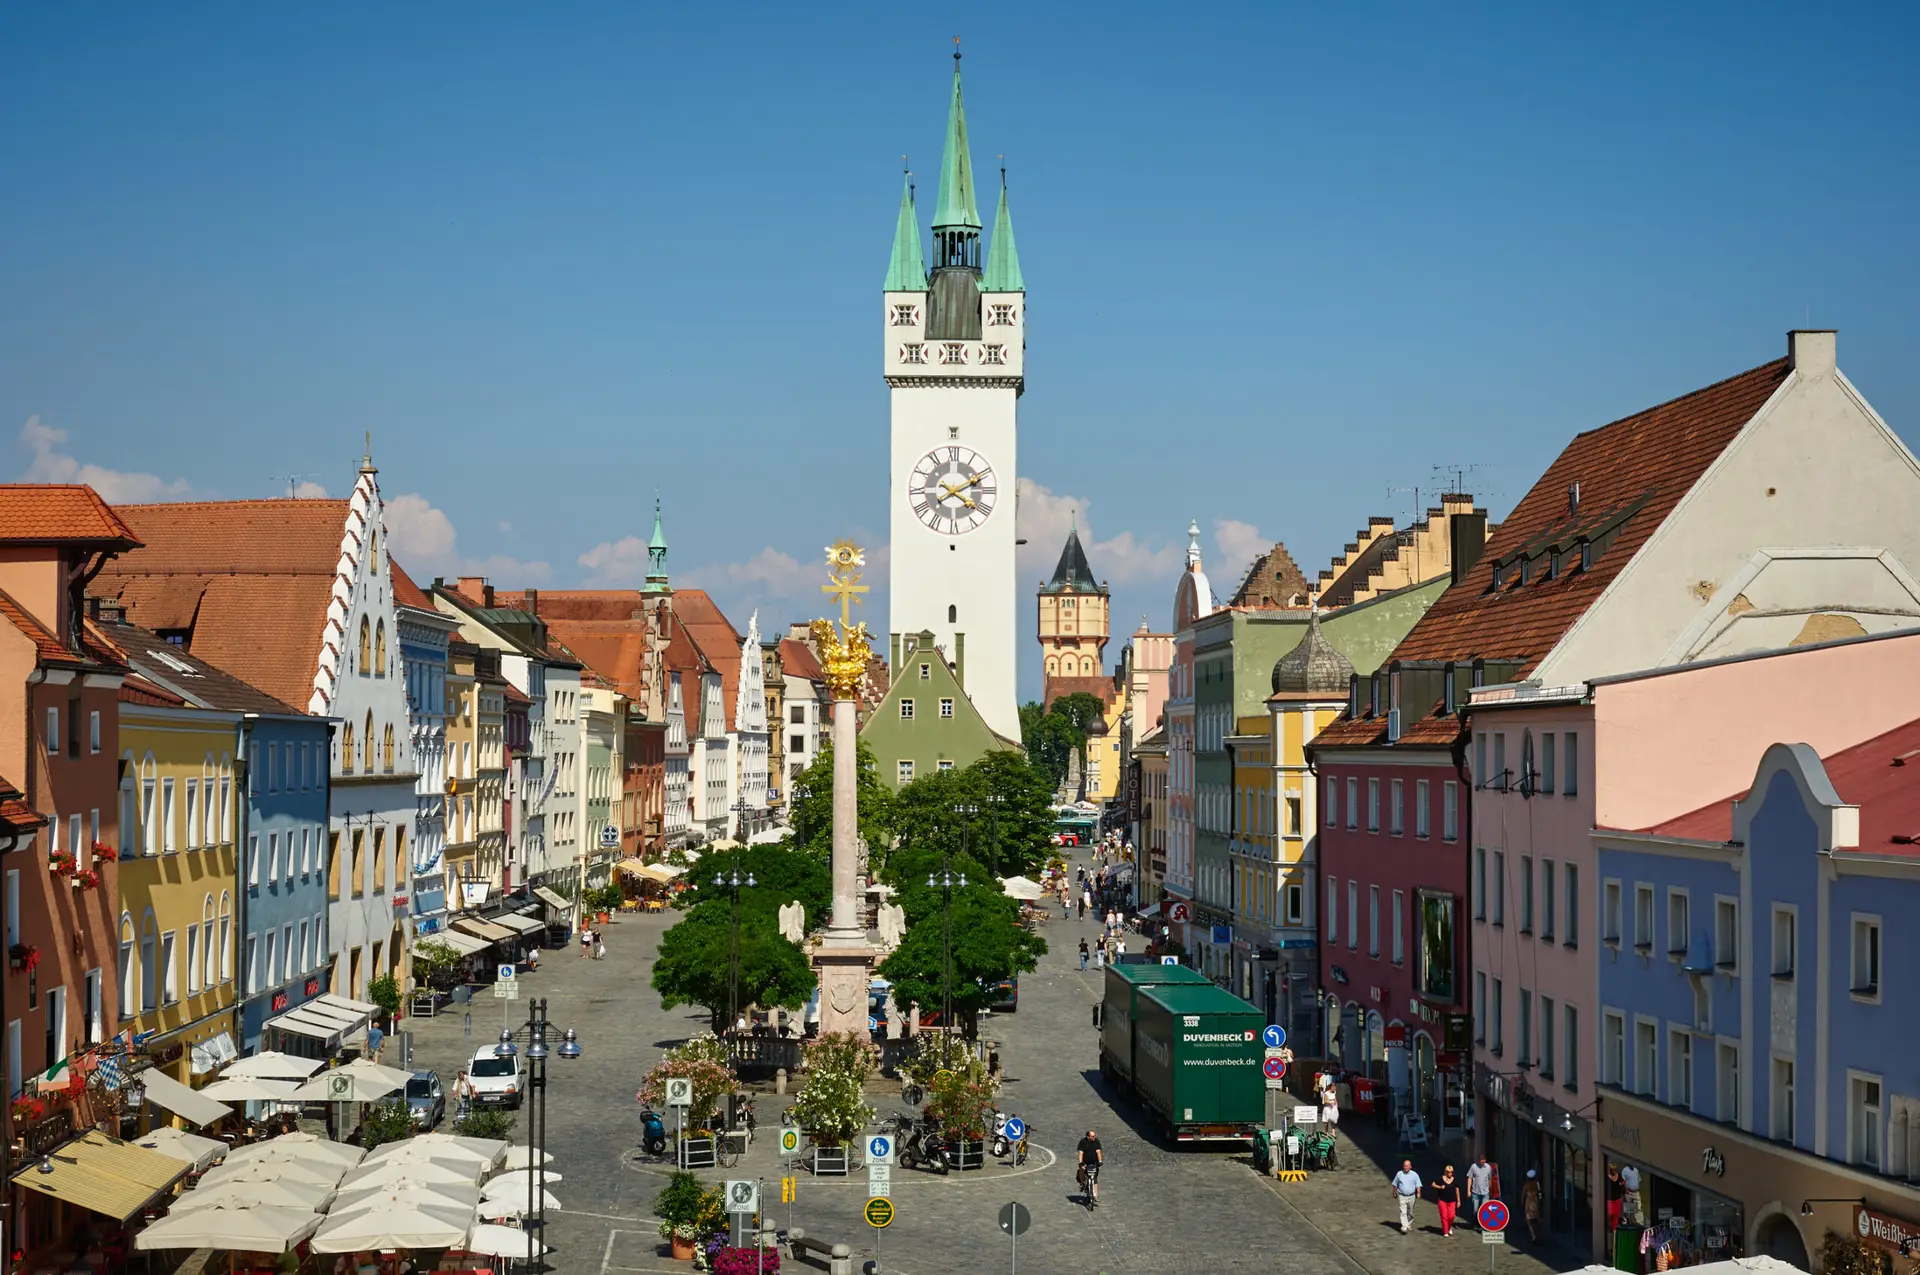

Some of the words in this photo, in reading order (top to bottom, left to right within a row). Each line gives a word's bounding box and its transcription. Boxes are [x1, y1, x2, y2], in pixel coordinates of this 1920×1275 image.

[1129, 769, 1139, 820] HOTEL
[1183, 1020, 1199, 1028] 3338
[1183, 1034, 1243, 1042] DUVENBECK
[1183, 1058, 1256, 1067] www.duvenbeck.de
